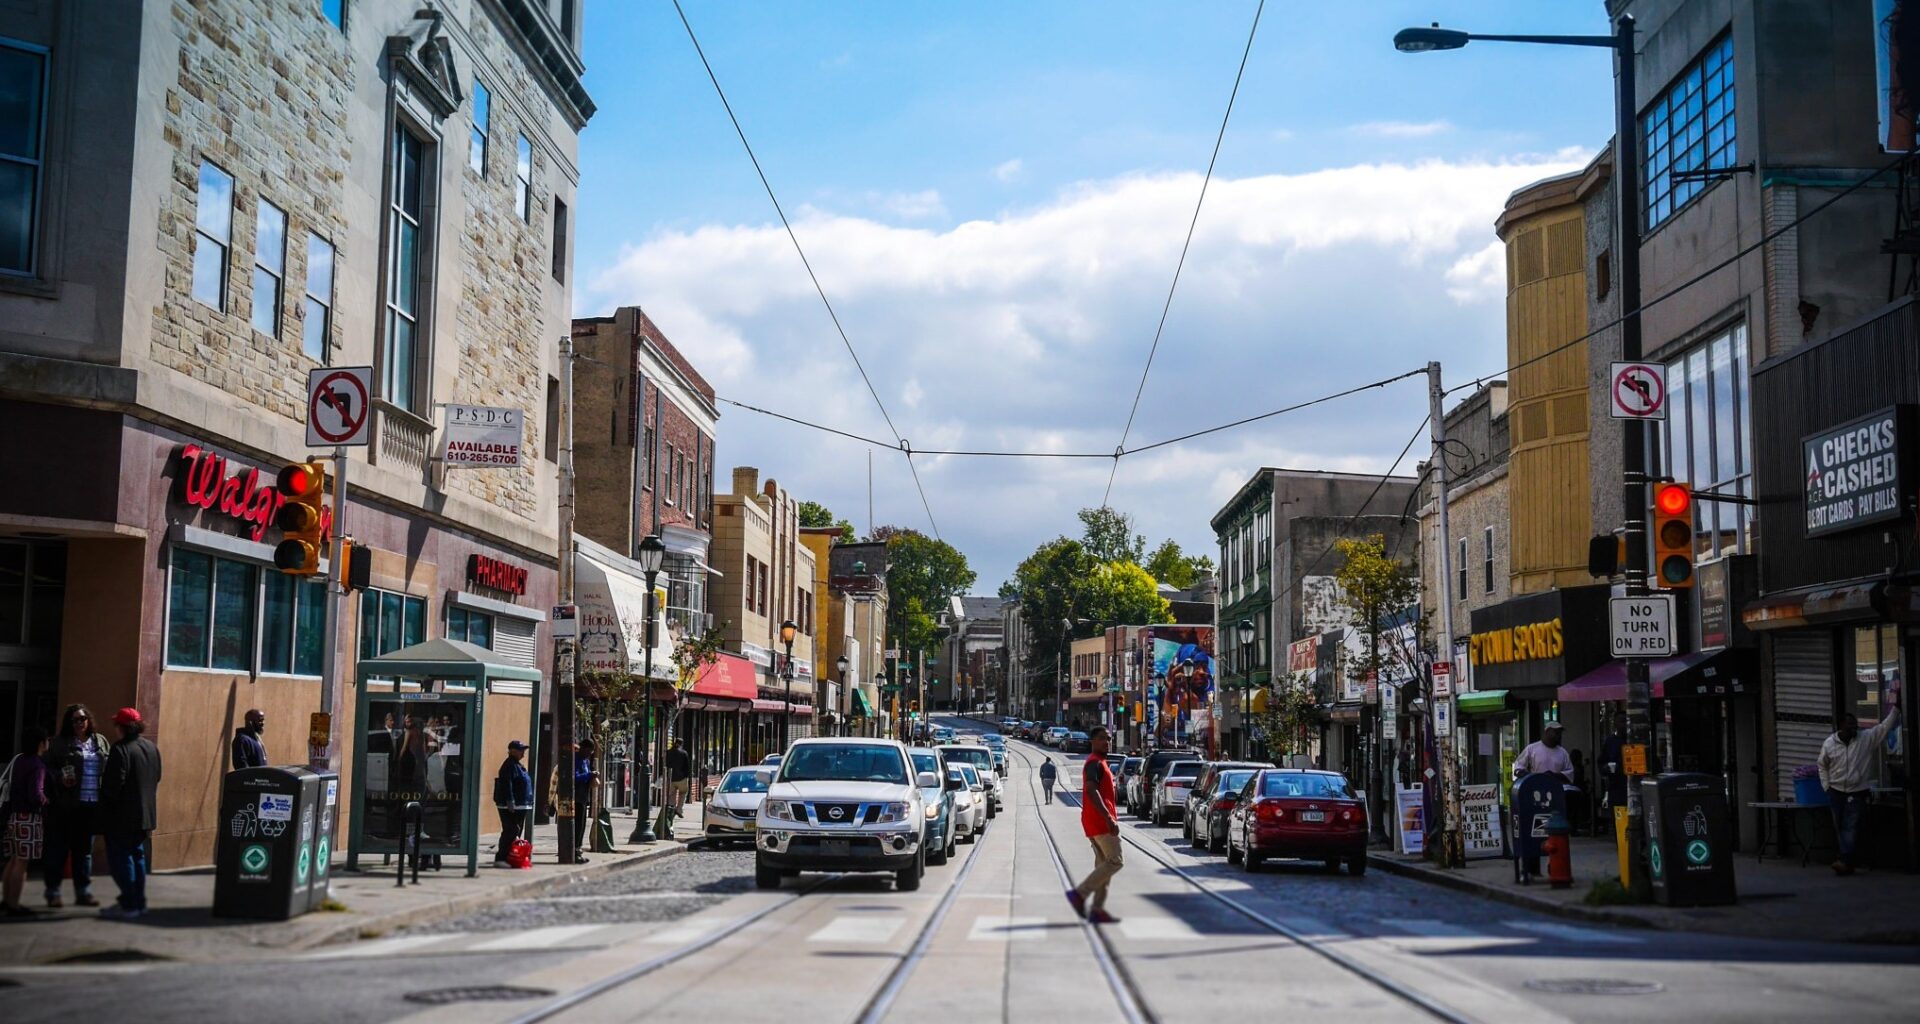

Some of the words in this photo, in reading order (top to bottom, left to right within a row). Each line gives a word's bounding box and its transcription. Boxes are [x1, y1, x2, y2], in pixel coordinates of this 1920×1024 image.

[448, 441, 518, 454] AVAILABLE
[1823, 419, 1894, 467] CHECKS
[447, 452, 517, 464] 610-265-6700
[1824, 452, 1896, 498] CASHED
[1807, 506, 1827, 529] DEBIT
[1828, 498, 1854, 523] CARDS
[1858, 493, 1873, 516] PAY
[1875, 487, 1897, 512] BILLS
[477, 554, 528, 595] PHARMACY
[1630, 605, 1652, 617] NO
[582, 612, 614, 627] Hook
[1622, 620, 1659, 633] TURN
[1514, 617, 1563, 661] SPORTS
[1615, 638, 1633, 649] ON
[1640, 637, 1666, 649] RED
[1459, 787, 1497, 804] Special
[1470, 814, 1489, 822] SALE
[1475, 822, 1489, 831] SEE
